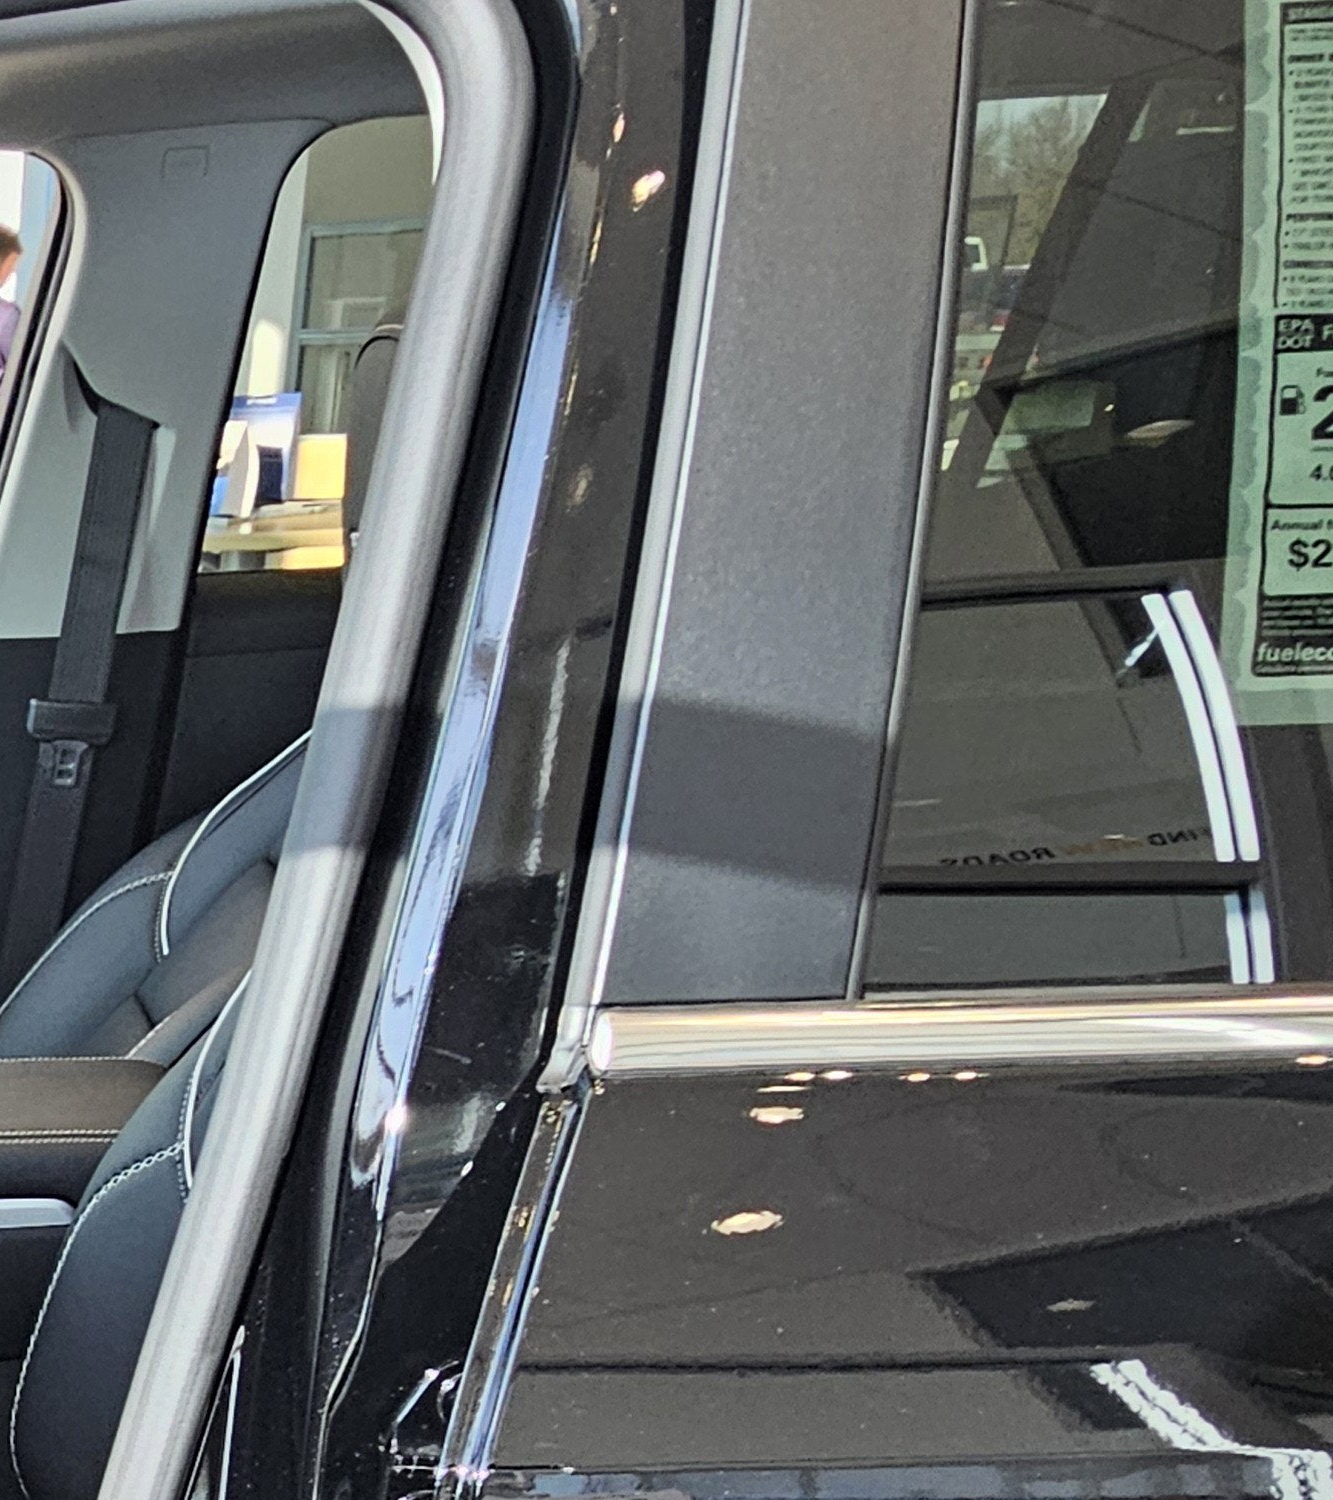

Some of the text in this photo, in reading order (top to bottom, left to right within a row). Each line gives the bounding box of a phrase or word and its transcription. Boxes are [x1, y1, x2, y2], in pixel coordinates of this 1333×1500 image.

[1279, 318, 1315, 332] EPA
[1277, 336, 1314, 349] DOT
[1270, 518, 1324, 531] Annual
